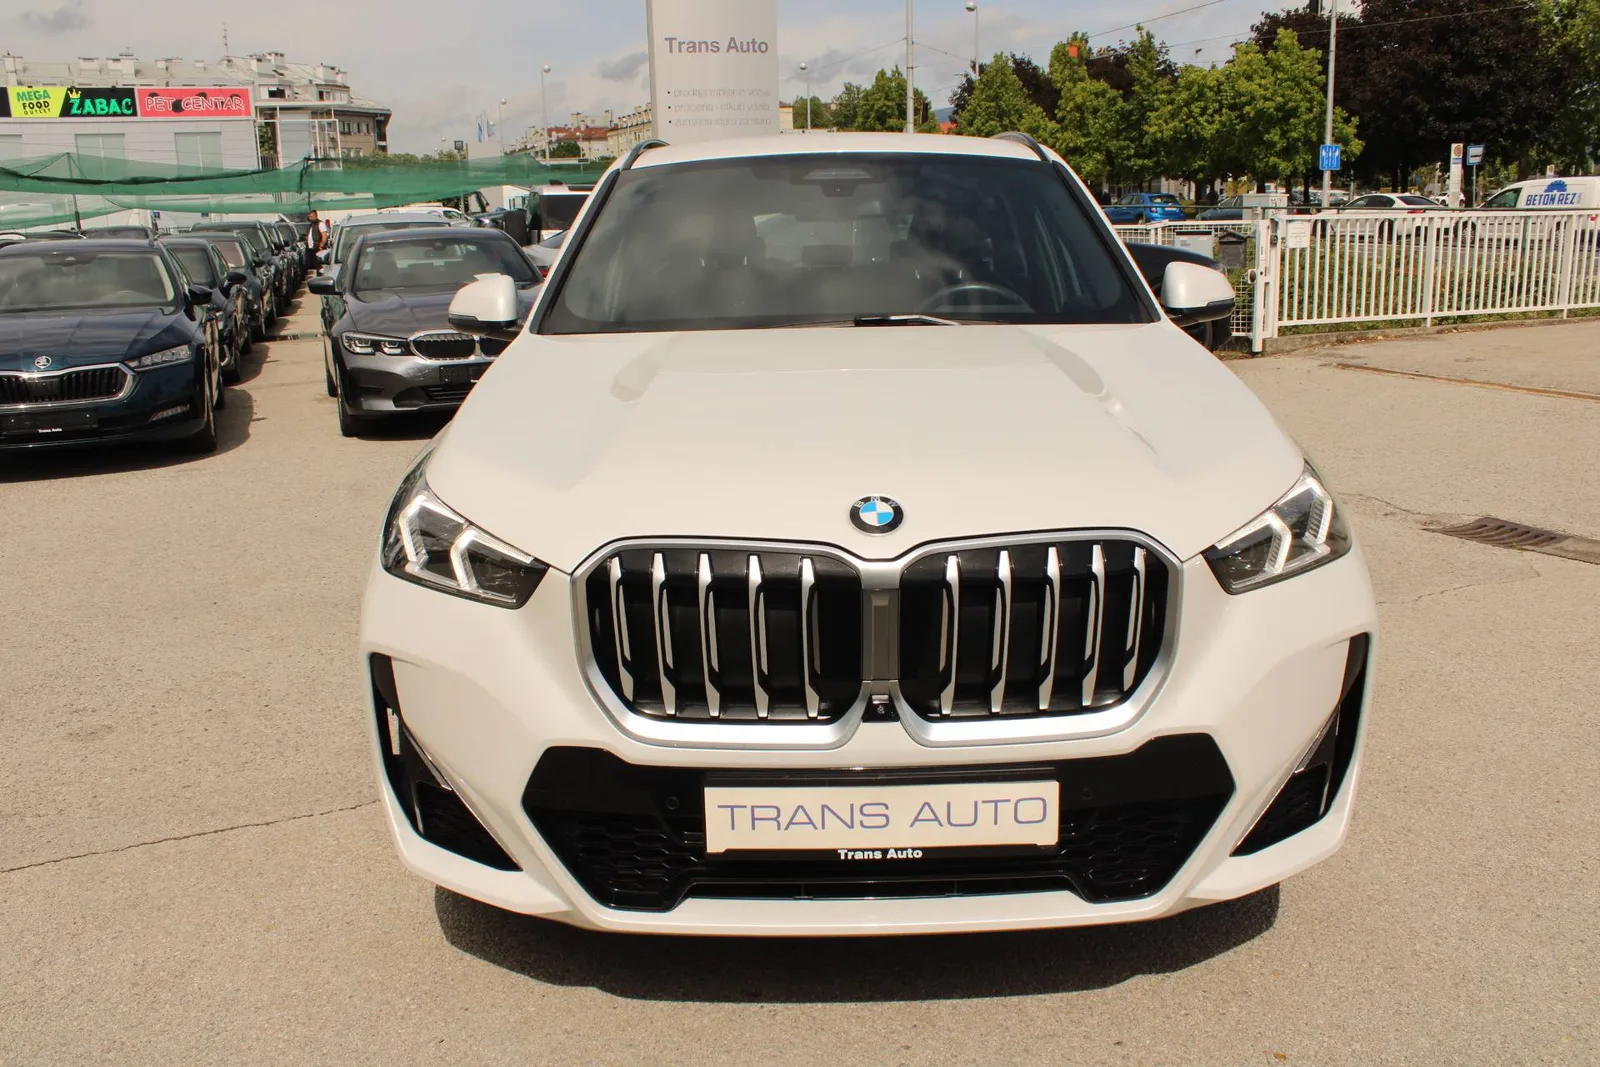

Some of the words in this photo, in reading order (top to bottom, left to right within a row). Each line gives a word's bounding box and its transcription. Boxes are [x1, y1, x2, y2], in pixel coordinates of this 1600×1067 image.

[664, 37, 720, 54] Trans
[726, 37, 769, 54] Auto
[16, 89, 51, 102] MEGA
[22, 100, 50, 110] FOOD
[145, 97, 176, 111] PET
[181, 96, 244, 111] CENTAR
[23, 108, 51, 116] OUTLET
[1525, 193, 1556, 206] BETON
[1557, 192, 1577, 205] REZ
[717, 802, 890, 831] TRANS
[909, 797, 1047, 829] AUTO
[837, 849, 883, 860] Trans
[886, 848, 923, 859] Auto
